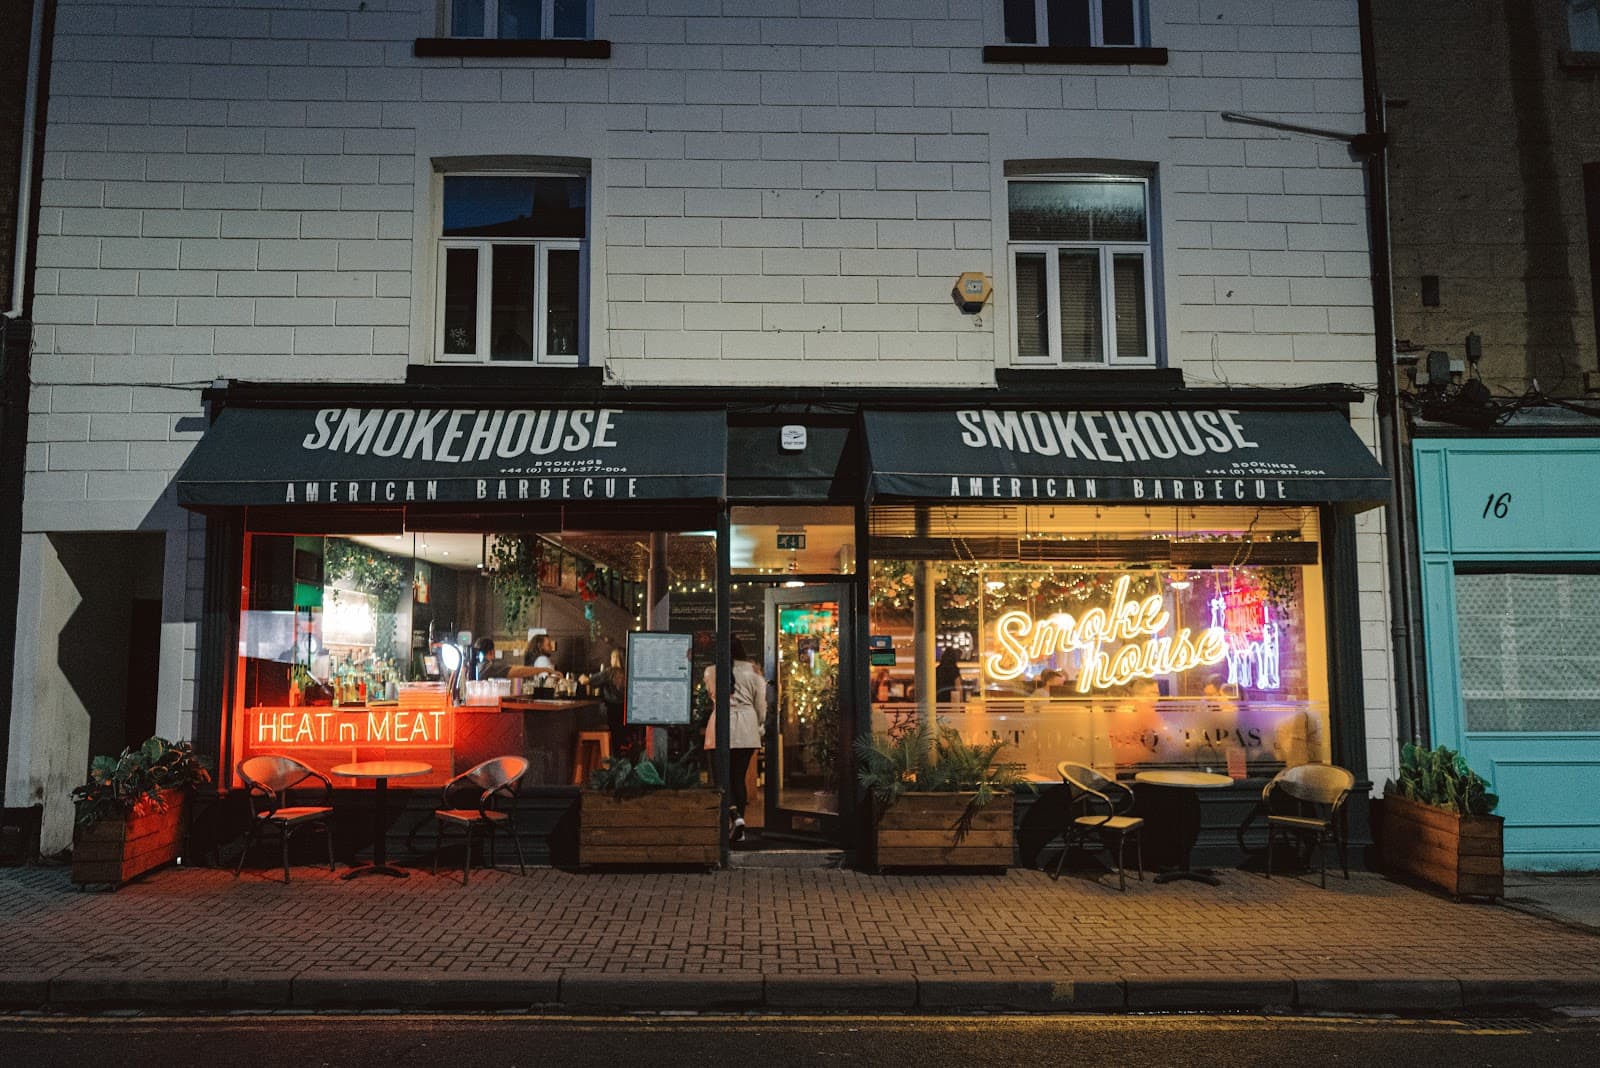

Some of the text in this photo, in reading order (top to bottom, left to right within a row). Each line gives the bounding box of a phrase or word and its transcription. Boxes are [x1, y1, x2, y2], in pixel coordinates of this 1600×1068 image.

[303, 408, 624, 463] SMOKEHOUSE
[956, 409, 1259, 463] SMOKEHOUSE
[546, 465, 628, 473] 1924-377-004
[1232, 461, 1297, 469] BOOKINGS
[285, 478, 637, 502] AMERICAN BARBECUE
[951, 477, 1286, 499] AMERICAN BARBECUE
[1482, 492, 1512, 519] 16
[985, 574, 1170, 681] Smoke
[1076, 627, 1227, 693] house
[258, 711, 446, 743] HEAT n MEAT
